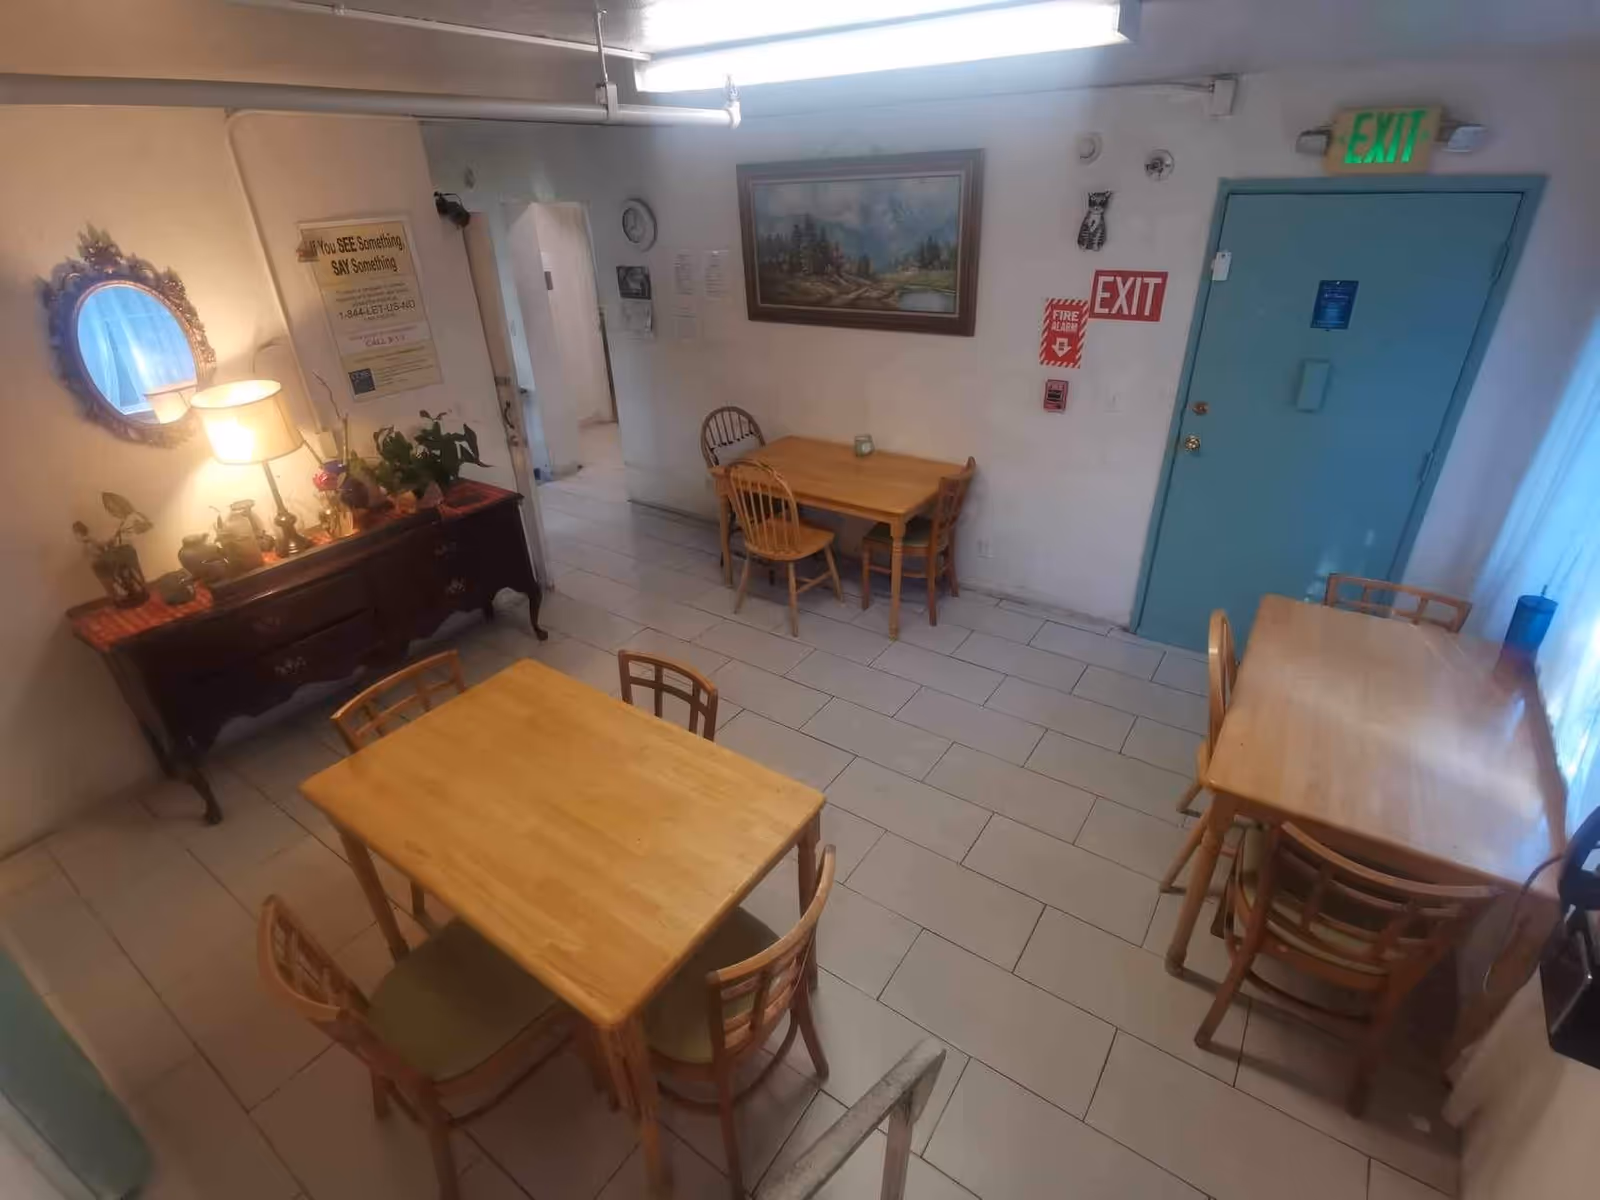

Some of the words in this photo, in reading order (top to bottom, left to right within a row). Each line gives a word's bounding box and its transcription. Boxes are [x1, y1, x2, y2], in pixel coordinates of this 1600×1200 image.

[1345, 111, 1426, 164] EXIT
[318, 239, 337, 256] You
[337, 236, 358, 253] SEE
[331, 258, 351, 276] SAY
[351, 256, 398, 273] Something
[1094, 276, 1162, 316] EXIT
[1052, 309, 1080, 322] FIRE
[1051, 321, 1078, 332] ALARM
